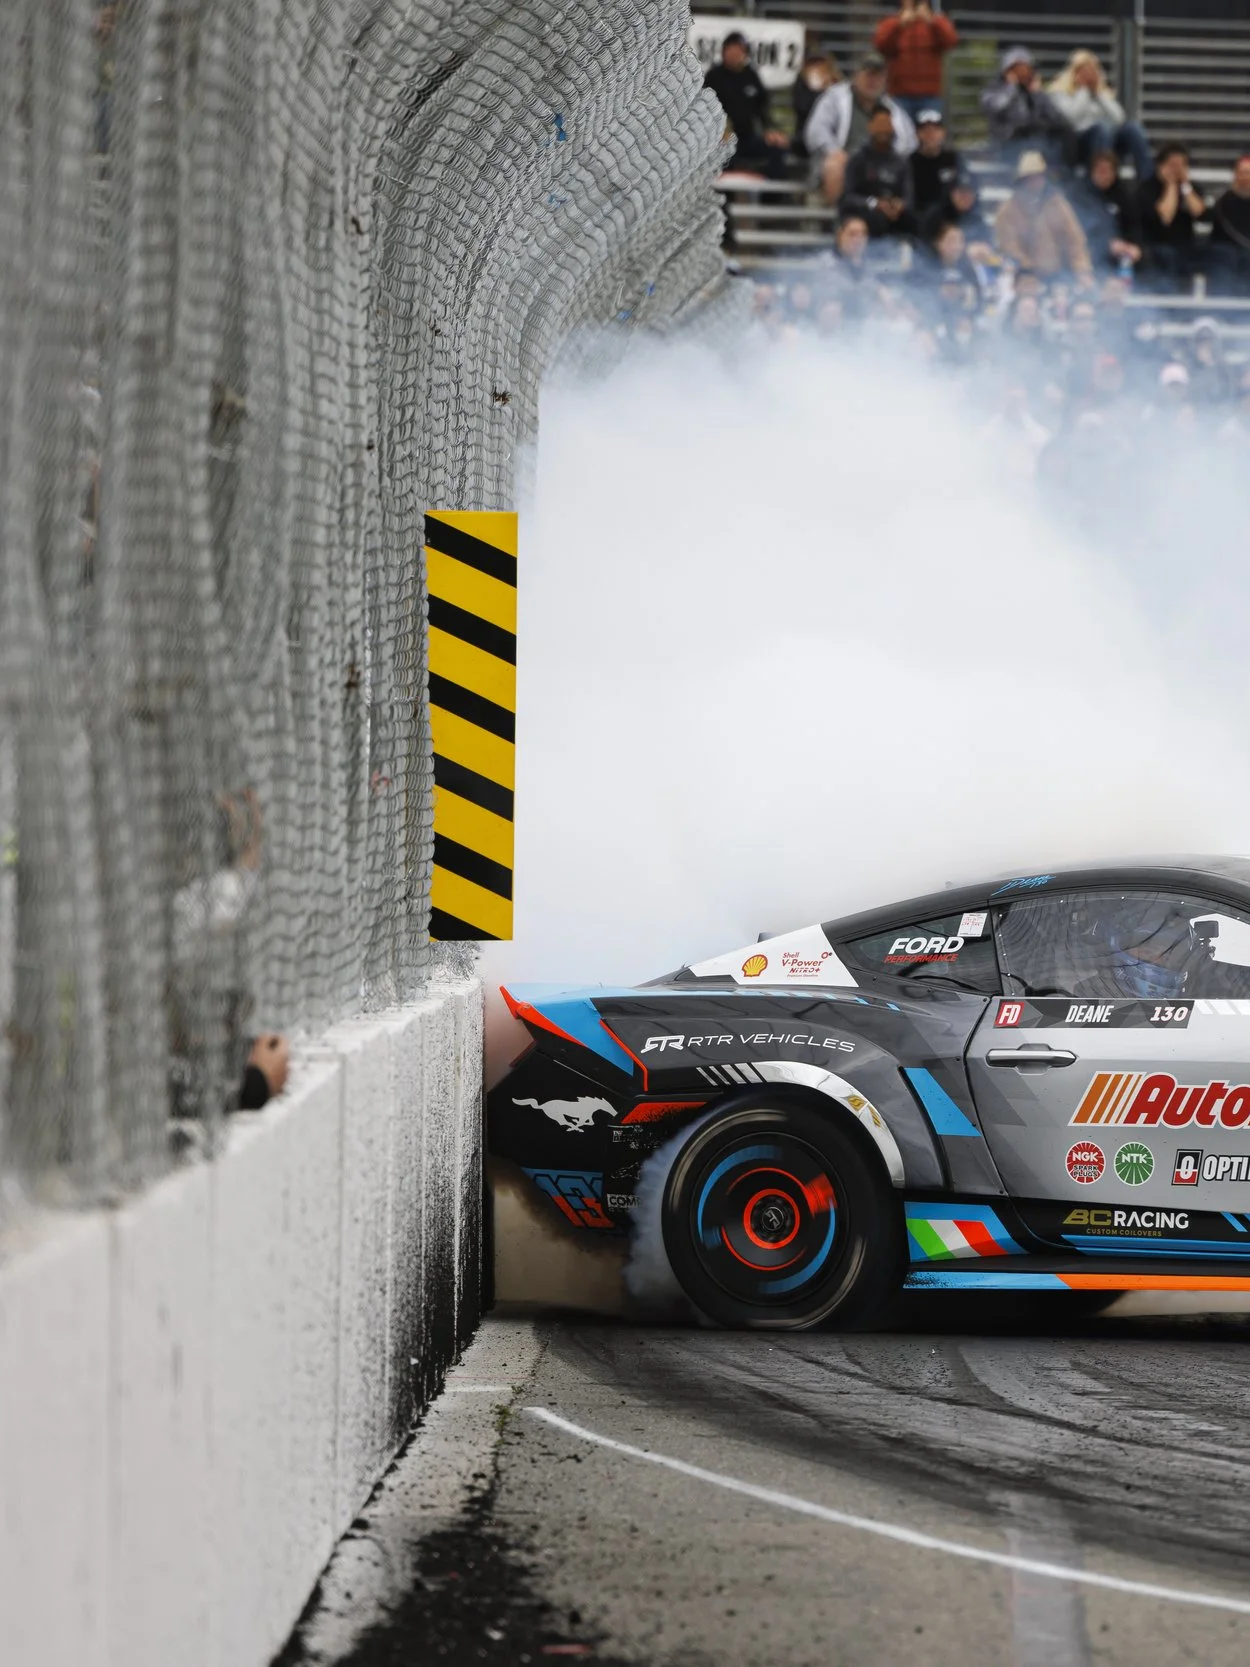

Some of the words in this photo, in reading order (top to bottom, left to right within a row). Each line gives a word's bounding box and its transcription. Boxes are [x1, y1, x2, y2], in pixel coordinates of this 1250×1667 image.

[888, 936, 965, 955] FORD
[883, 953, 959, 964] PERFORMANCE
[998, 1004, 1021, 1024] FD
[1065, 1005, 1114, 1023] DEANE
[1150, 1006, 1189, 1022] 130
[688, 1035, 734, 1047] RTR
[739, 1034, 856, 1052] VEHICLES
[1072, 1152, 1098, 1162] NGK
[1121, 1153, 1147, 1163] NTK
[1113, 1210, 1189, 1229] RACING
[1119, 1229, 1162, 1237] COILOVERS
